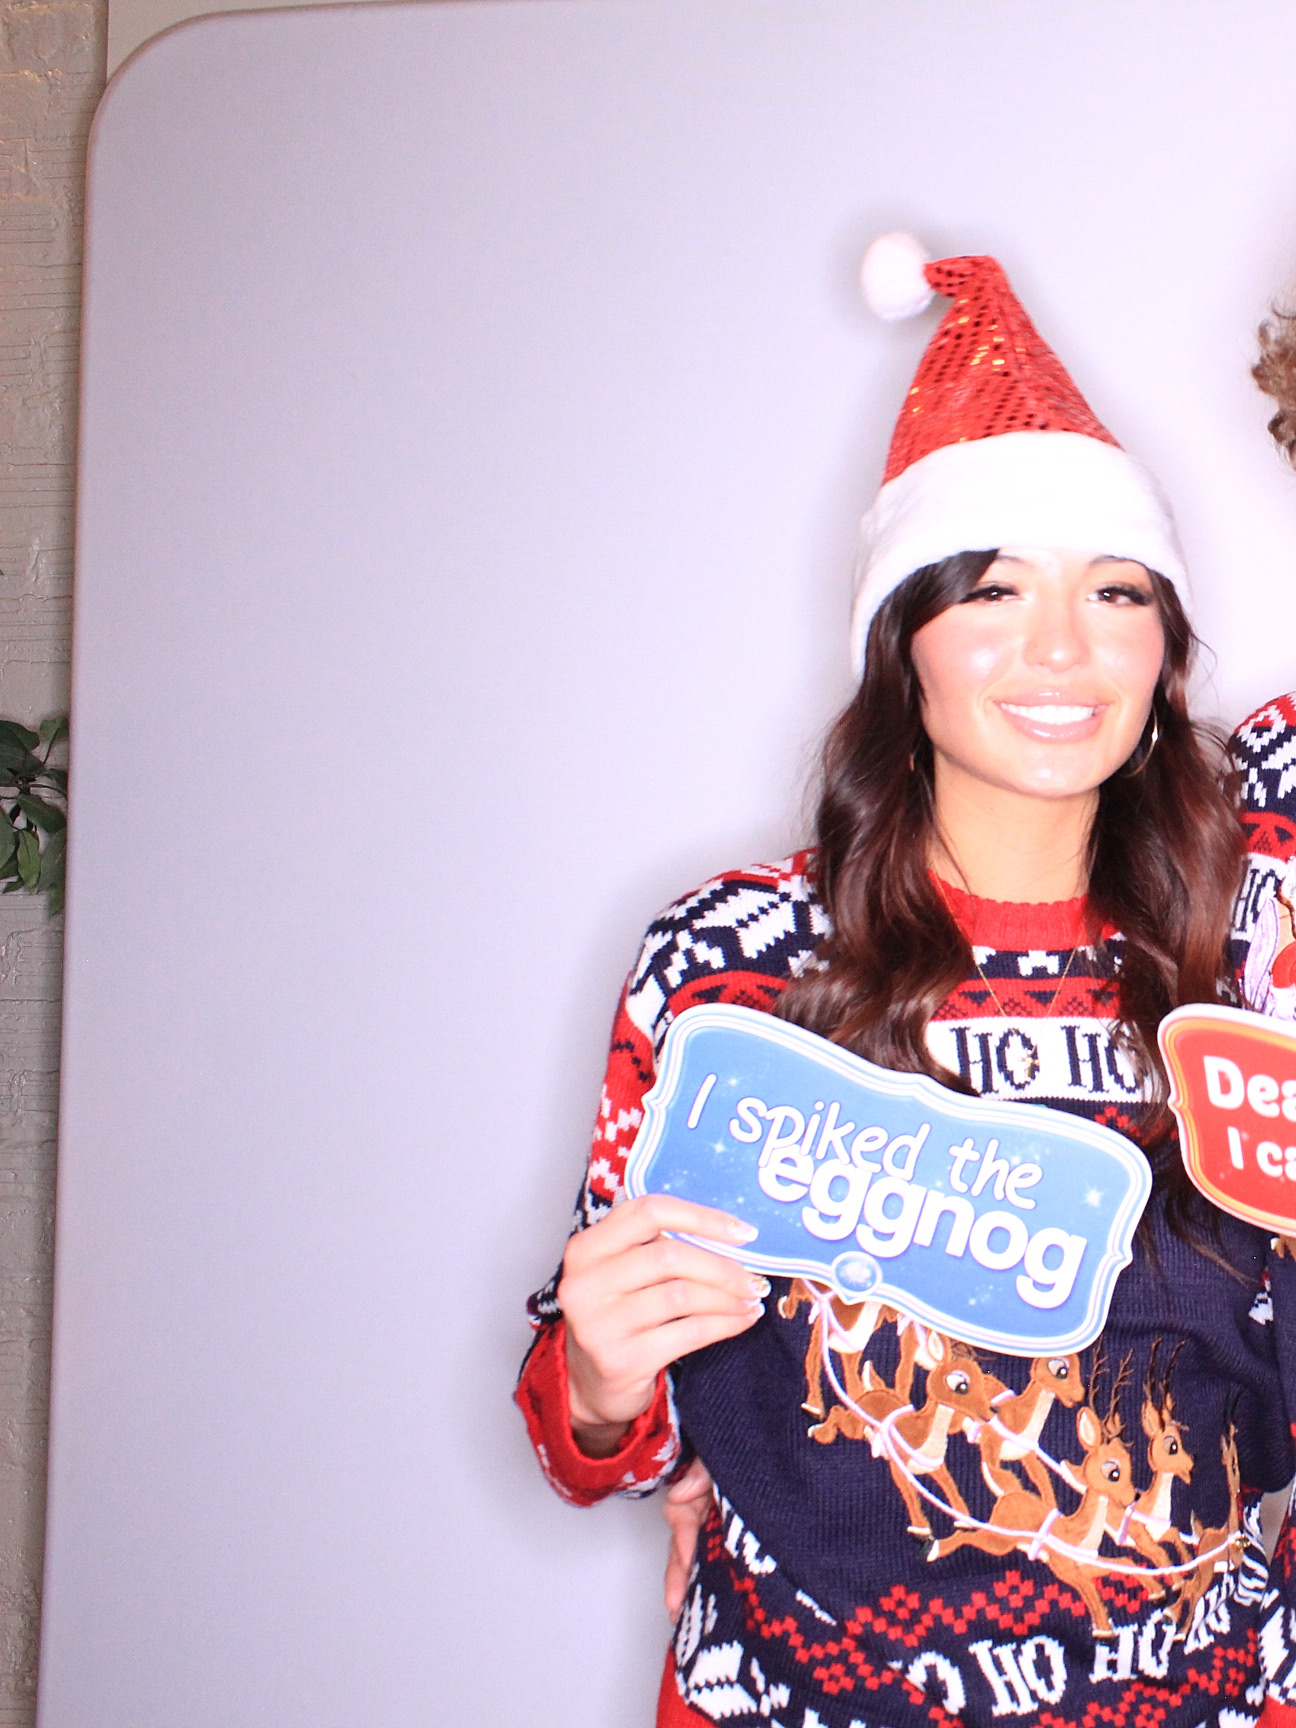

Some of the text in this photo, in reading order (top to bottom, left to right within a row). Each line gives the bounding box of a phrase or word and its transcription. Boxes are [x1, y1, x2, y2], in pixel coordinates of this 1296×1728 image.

[950, 1026, 1041, 1095] HO
[686, 1074, 1043, 1209] I spiked the
[1227, 1127, 1244, 1170] I
[758, 1145, 1088, 1309] eggnog
[968, 1634, 1068, 1717] HO
